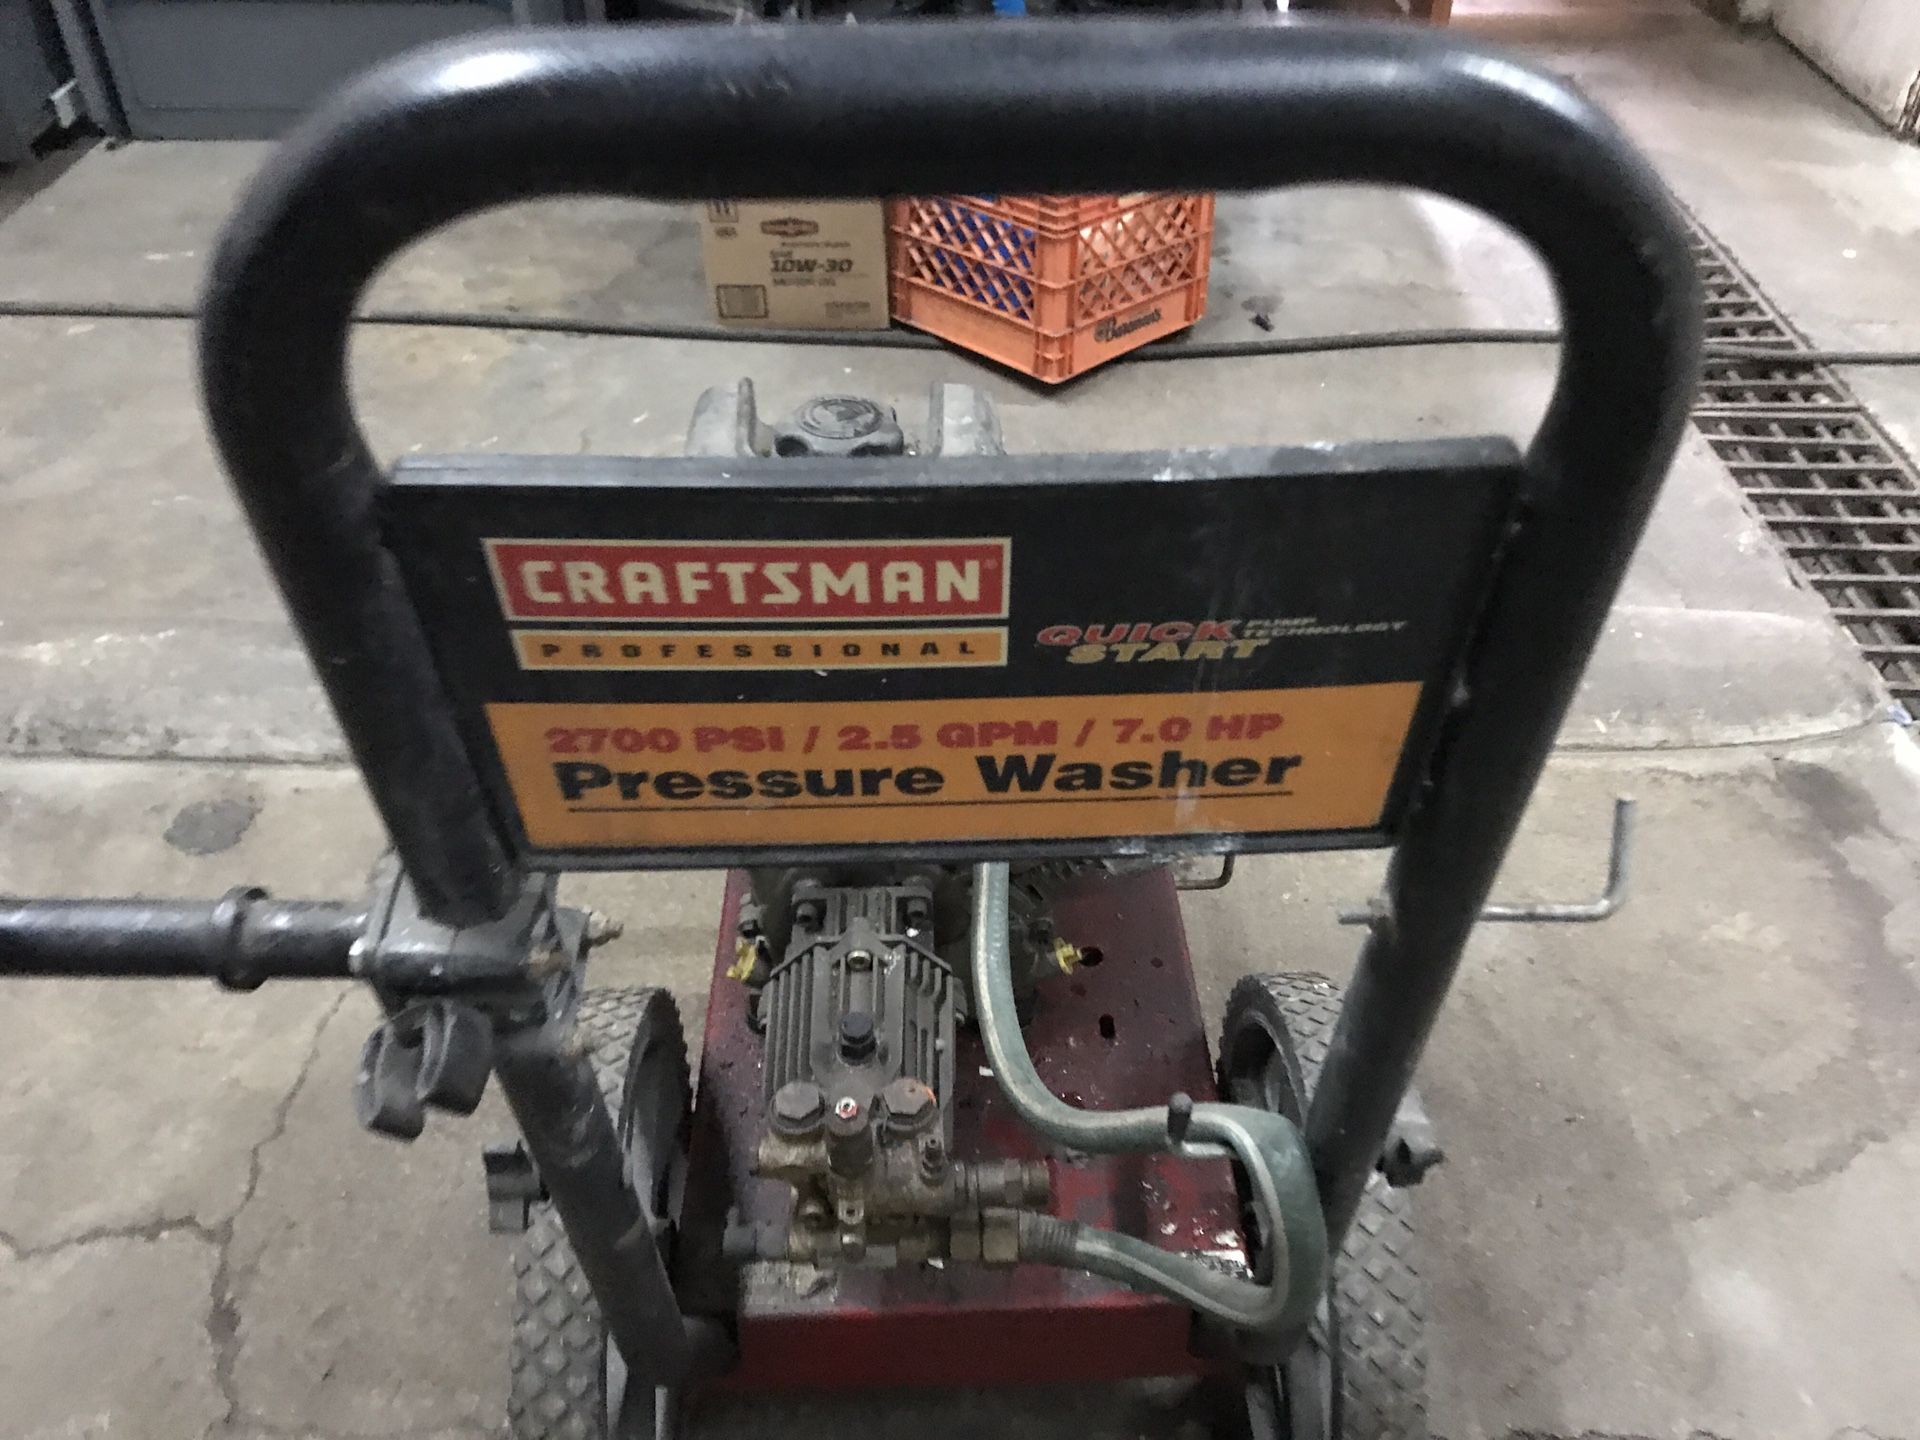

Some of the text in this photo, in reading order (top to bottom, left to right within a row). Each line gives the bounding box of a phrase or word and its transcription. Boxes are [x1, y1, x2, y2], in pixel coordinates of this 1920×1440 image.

[770, 258, 854, 273] 10W-30
[519, 560, 981, 604] CRAFTSMAN
[1036, 620, 1237, 646] QUICK
[1244, 620, 1408, 638] TECHNOLOGY
[541, 641, 976, 659] PROFESSIONAL
[1066, 638, 1271, 664] START
[545, 713, 1284, 754] 2700 PSI / 2.5 GPM / 7.0 HP
[553, 750, 1303, 800] Pressure Washer
